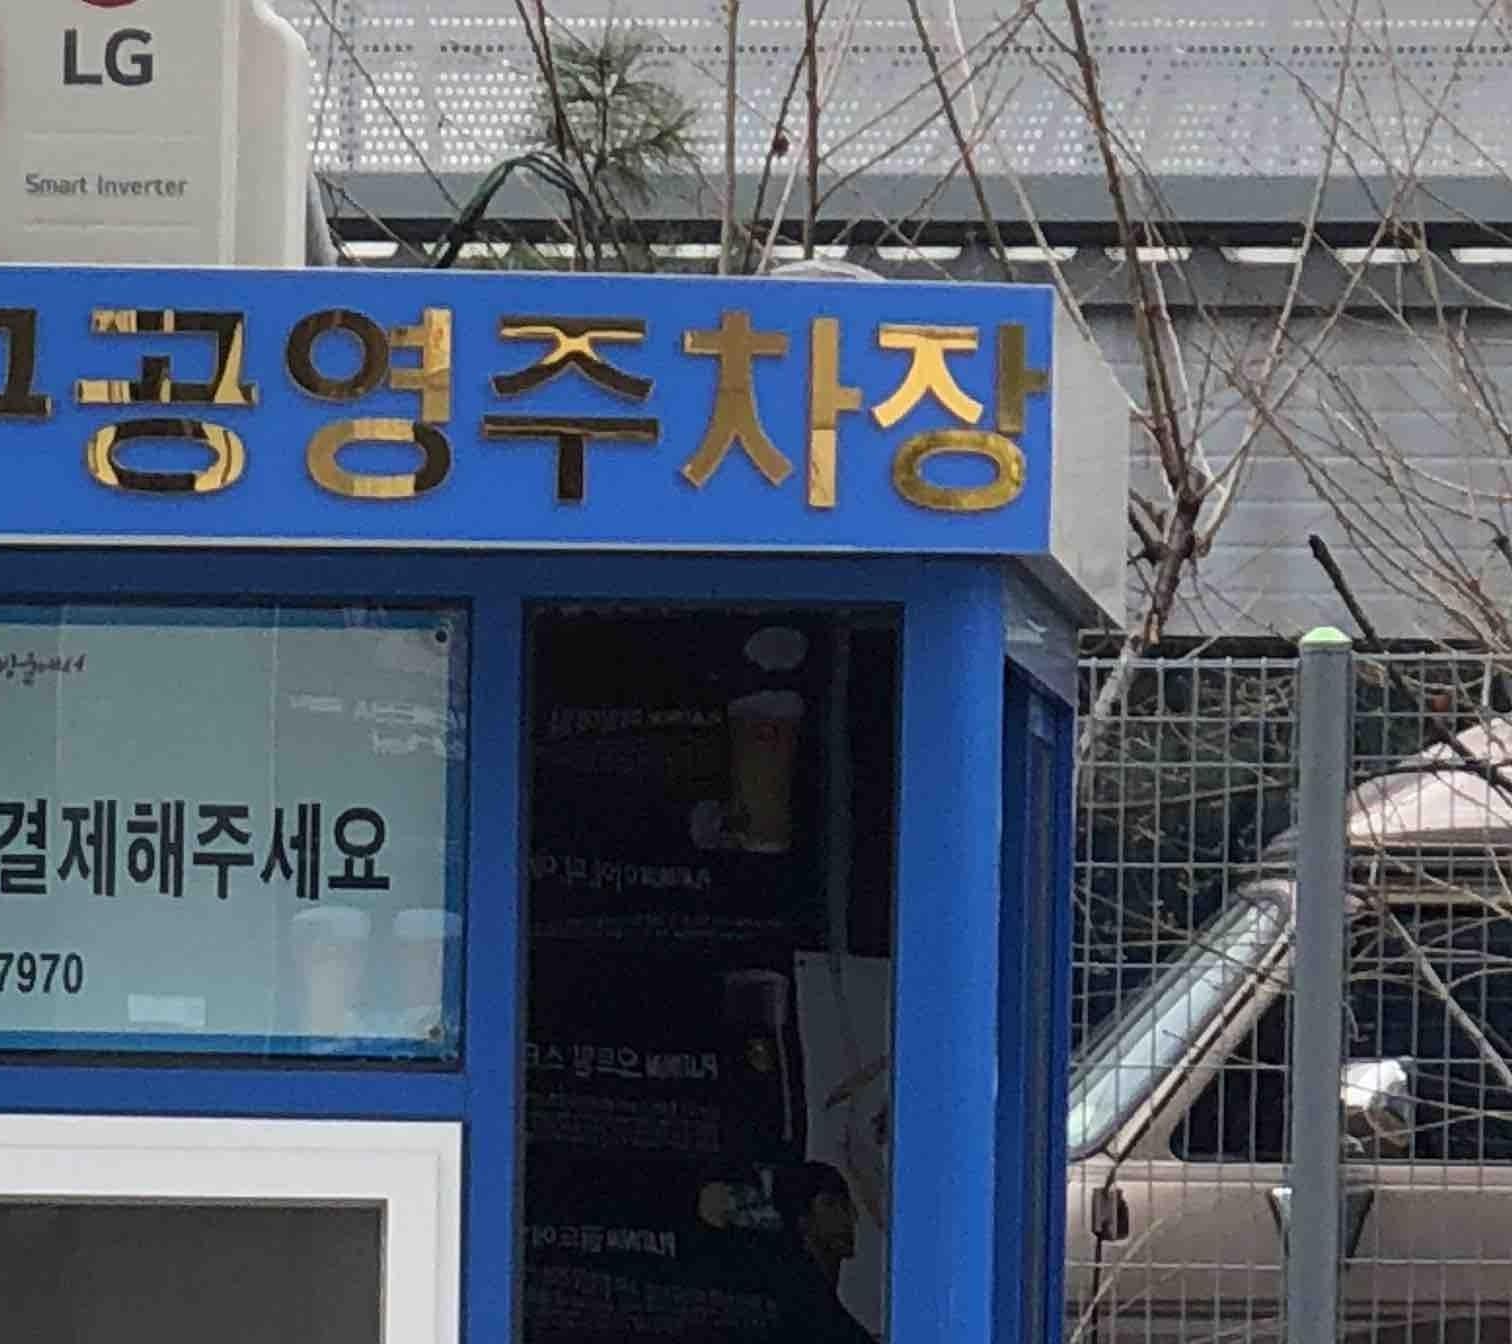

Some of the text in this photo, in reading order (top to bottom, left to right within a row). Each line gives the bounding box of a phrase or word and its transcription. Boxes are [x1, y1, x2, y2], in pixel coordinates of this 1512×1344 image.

[63, 28, 154, 87] LG
[25, 173, 188, 198] Smart Inverter
